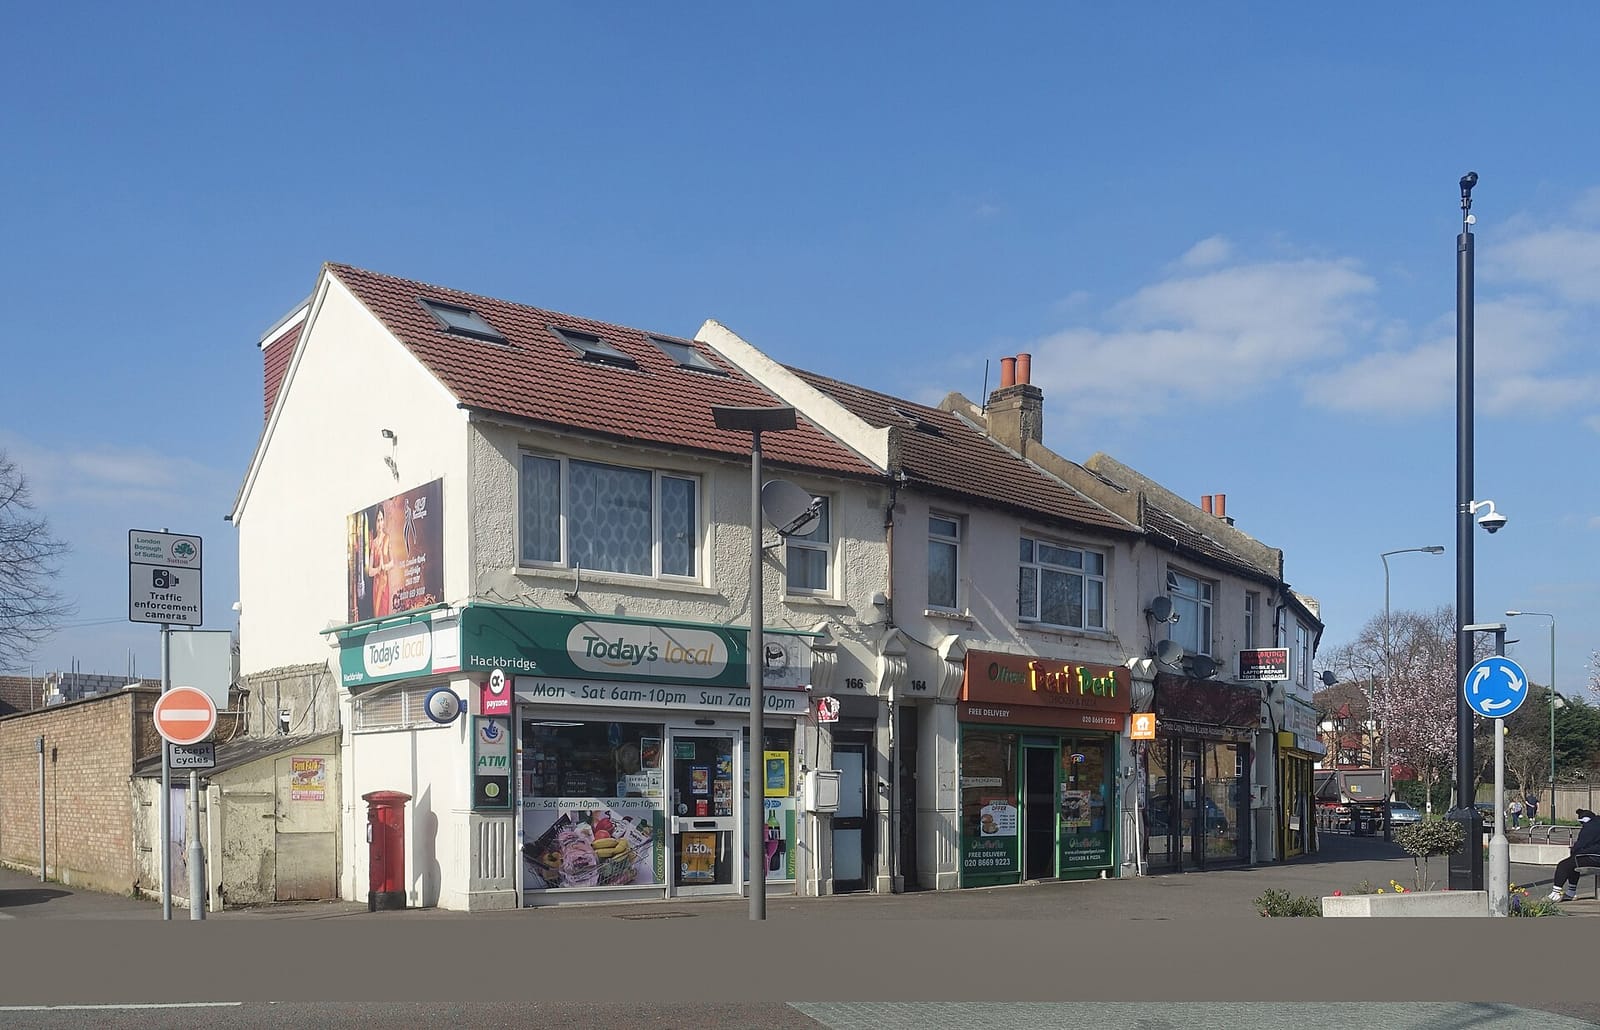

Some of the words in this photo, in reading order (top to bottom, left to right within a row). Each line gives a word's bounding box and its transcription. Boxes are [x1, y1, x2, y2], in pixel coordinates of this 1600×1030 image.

[136, 537, 161, 545] London
[134, 544, 162, 552] Borough
[149, 592, 182, 602] Traffic
[134, 601, 198, 612] enforcement
[145, 611, 187, 621] cameras
[370, 642, 399, 666] Today's
[402, 634, 425, 659] local
[583, 635, 658, 665] Today's
[664, 641, 714, 666] local
[470, 655, 537, 670] Hackbridge
[845, 678, 864, 689] 166
[911, 680, 927, 690] 164
[1076, 666, 1116, 698] Peri
[533, 682, 565, 698] Mon
[581, 685, 606, 699] Sat
[611, 686, 686, 705] 6am-10pm
[700, 690, 723, 706] Sun
[728, 692, 795, 710] 7am10pm
[487, 699, 508, 710] payzone
[968, 708, 982, 716] FREE
[983, 709, 1010, 717] DELIVERY
[174, 747, 210, 756] Except
[176, 755, 208, 765] cycles
[478, 755, 506, 767] ATM
[543, 800, 556, 808] Sat
[559, 800, 600, 809] 6am-10pm
[606, 800, 619, 808] Sun
[621, 800, 660, 809] 7am-10pm
[656, 853, 664, 881] Grocery
[964, 859, 977, 867] 020
[978, 858, 994, 866] 8669
[995, 858, 1011, 866] 9223
